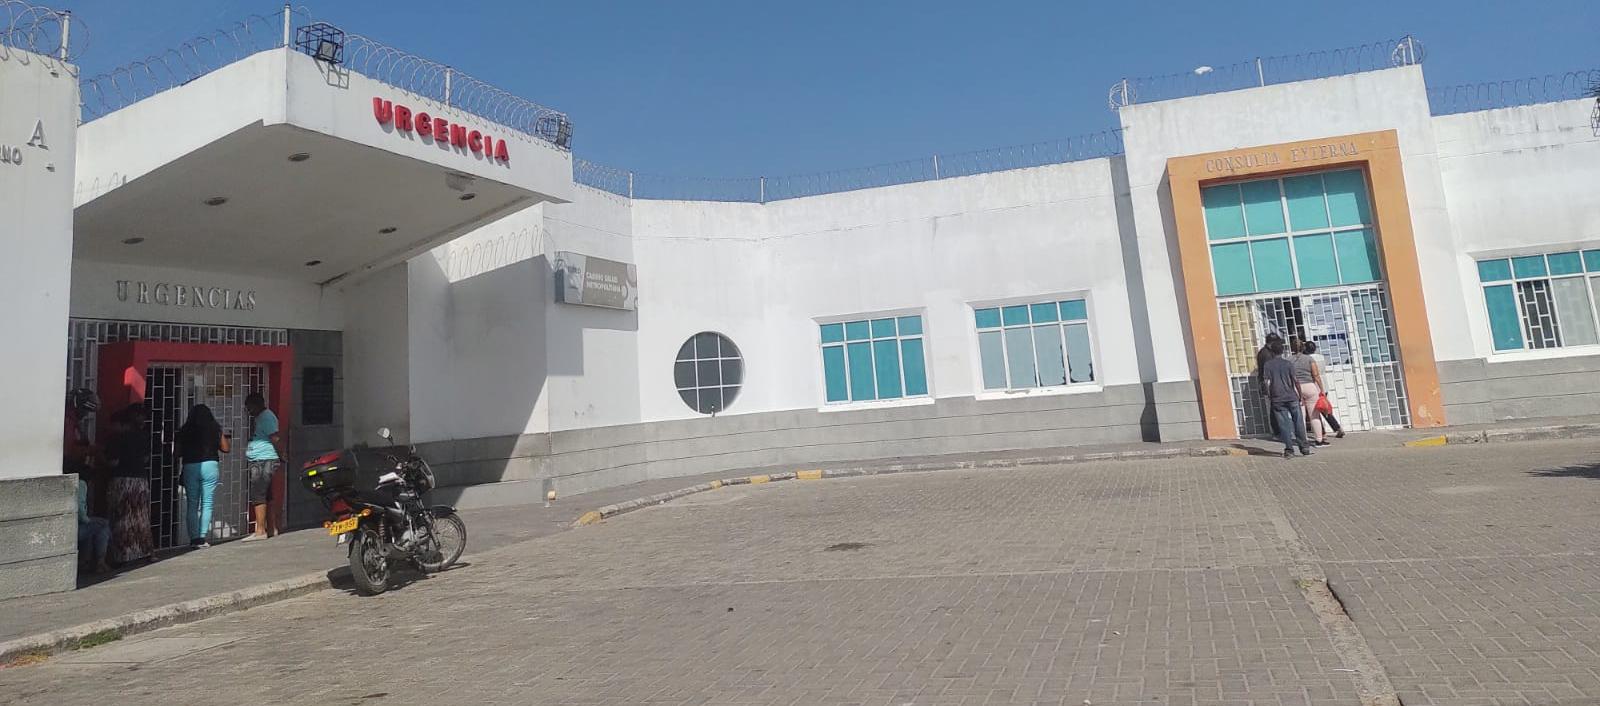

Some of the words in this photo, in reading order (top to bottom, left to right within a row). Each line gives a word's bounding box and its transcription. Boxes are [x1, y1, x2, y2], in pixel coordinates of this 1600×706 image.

[373, 96, 510, 162] URGENCIA
[1205, 152, 1280, 172] CONSULTA
[1291, 142, 1359, 162] EXTERNA
[116, 279, 256, 311] URGENCIAS
